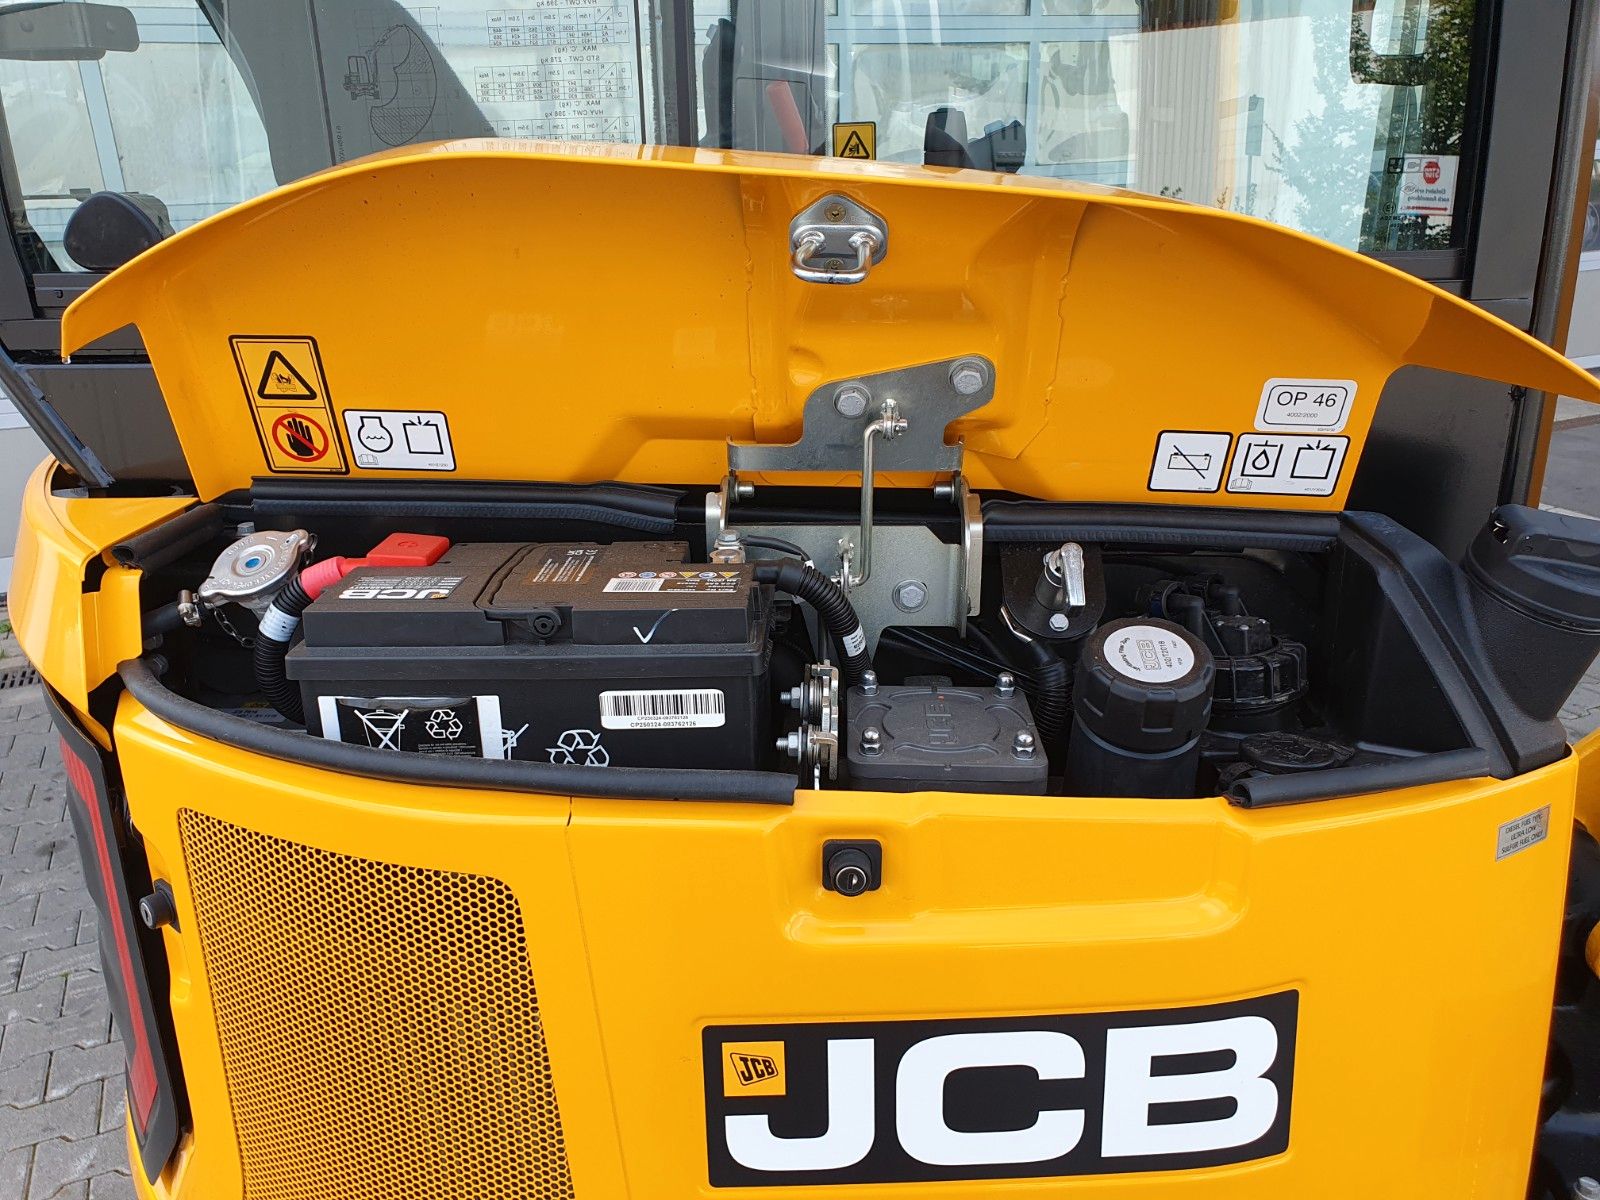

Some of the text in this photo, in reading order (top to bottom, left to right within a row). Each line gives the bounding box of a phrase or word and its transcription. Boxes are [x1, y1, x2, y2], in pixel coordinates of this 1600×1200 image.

[1277, 391, 1338, 408] OP 46
[338, 589, 450, 599] JCB
[1136, 640, 1162, 670] JCB
[737, 1054, 778, 1084] JCB
[725, 1016, 1279, 1171] JCB
